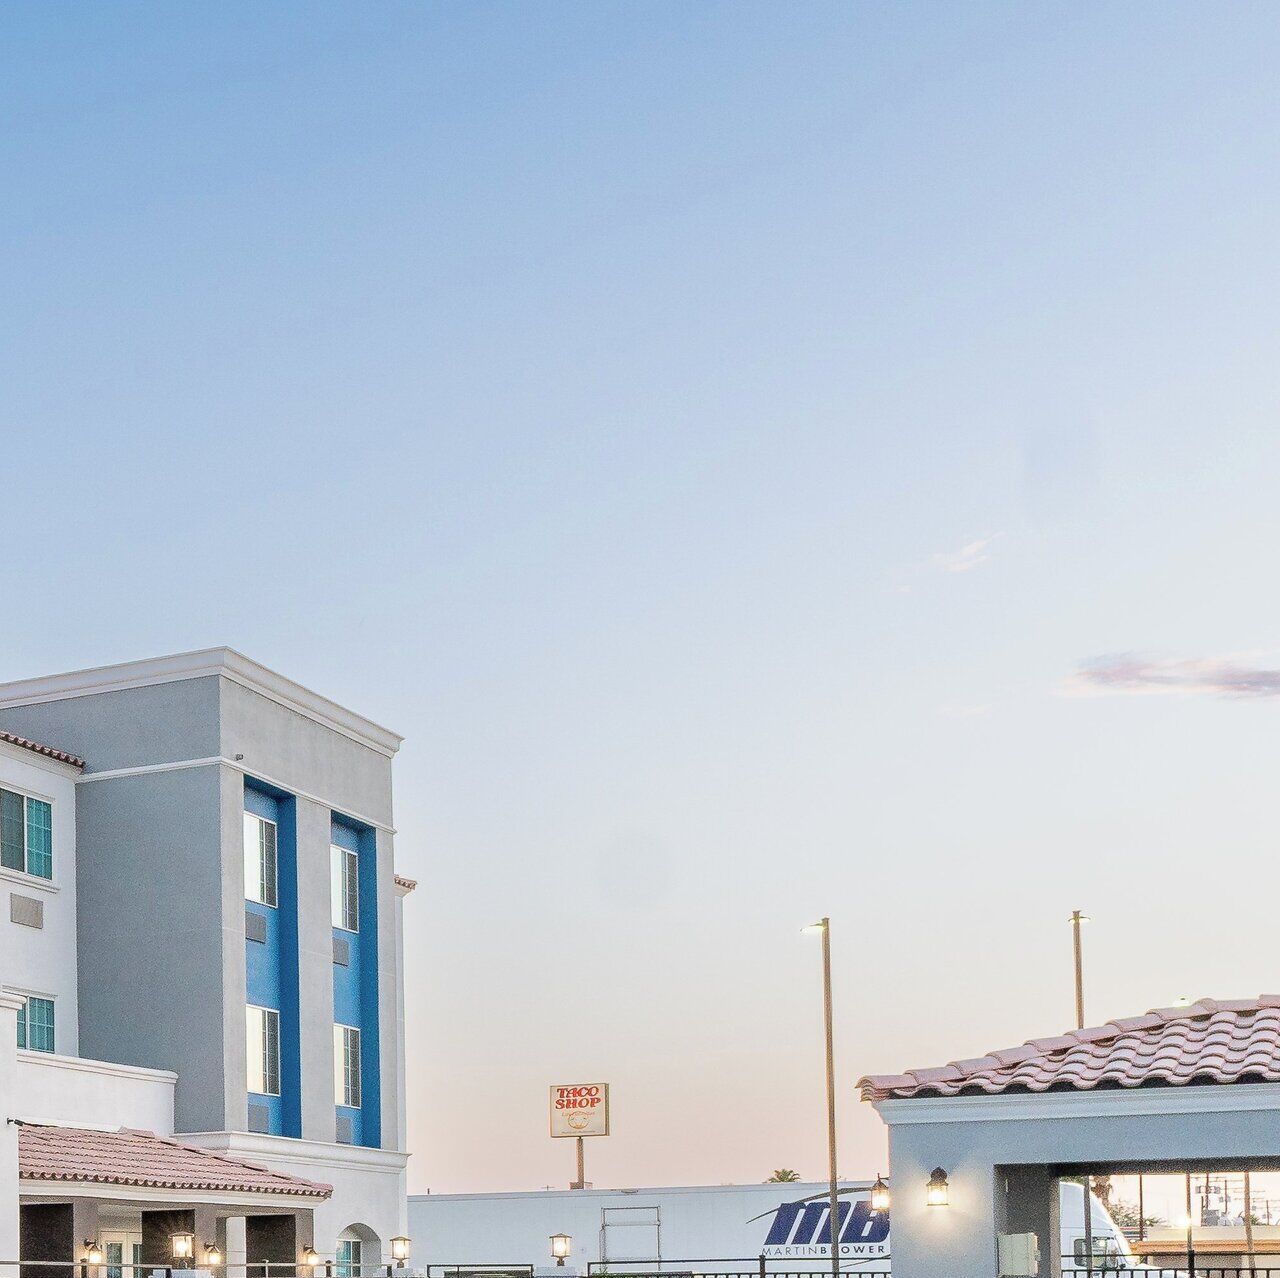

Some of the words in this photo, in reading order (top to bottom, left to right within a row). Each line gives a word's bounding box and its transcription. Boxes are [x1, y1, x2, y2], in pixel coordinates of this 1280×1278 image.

[557, 1086, 599, 1098] TACO
[555, 1097, 601, 1109] SHOP
[762, 1246, 884, 1255] MARTINBOWER
